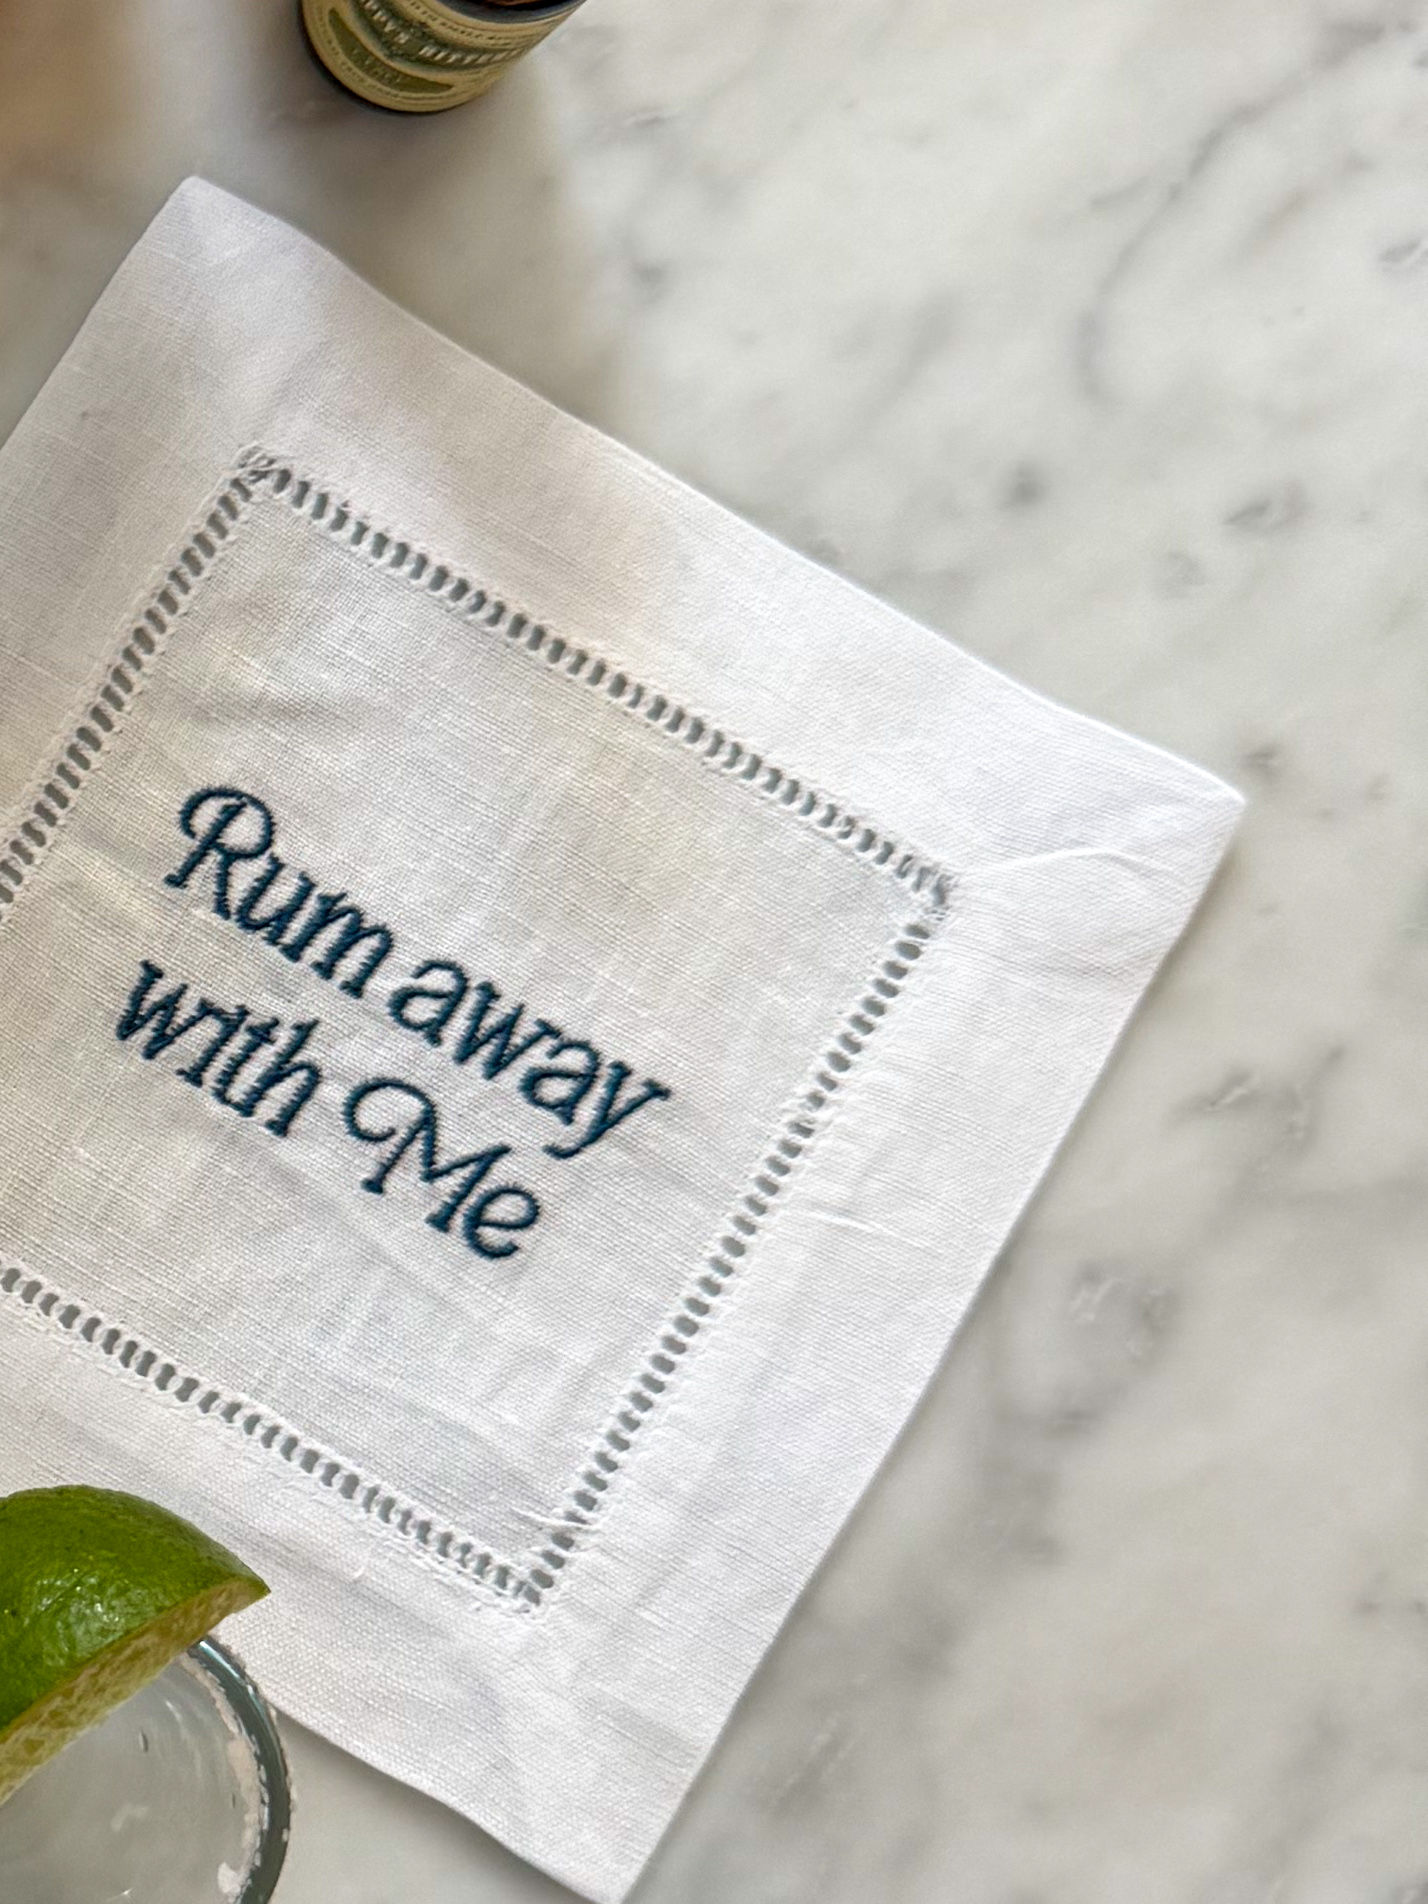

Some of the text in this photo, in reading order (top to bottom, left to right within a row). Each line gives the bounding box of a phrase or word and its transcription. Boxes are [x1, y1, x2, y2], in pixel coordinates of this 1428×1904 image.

[114, 959, 542, 1260] with Me
[162, 784, 674, 1160] Rum away
